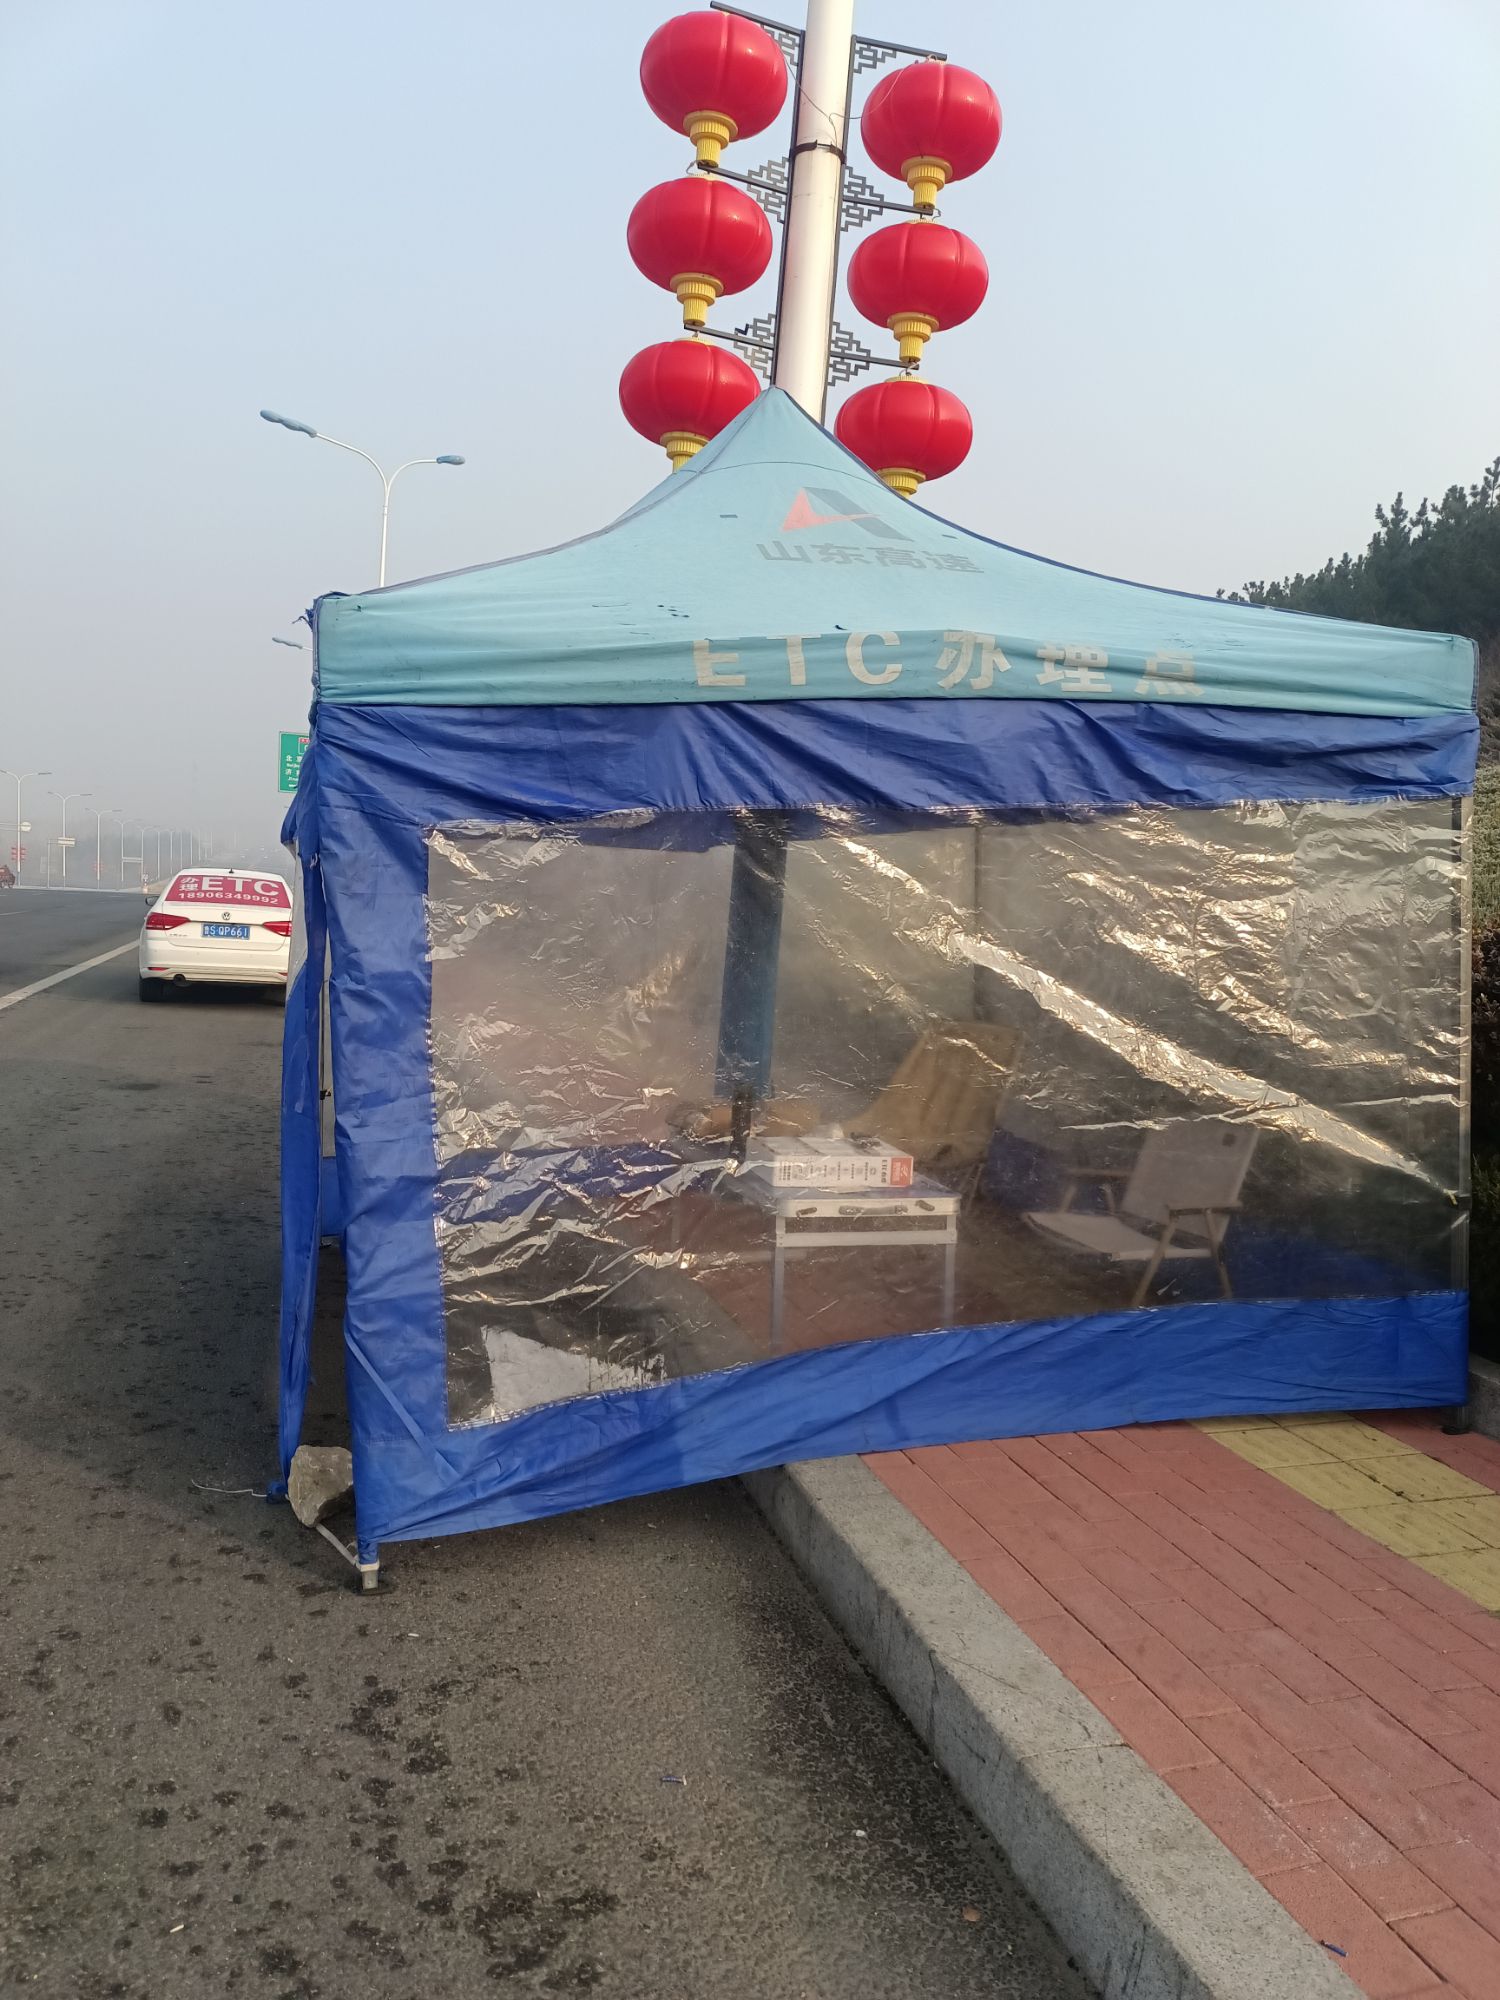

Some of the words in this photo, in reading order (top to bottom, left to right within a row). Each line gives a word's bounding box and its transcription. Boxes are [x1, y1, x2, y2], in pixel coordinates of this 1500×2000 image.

[756, 540, 985, 574] 山东高速
[201, 876, 279, 896] ETC
[178, 891, 279, 904] 18906349992
